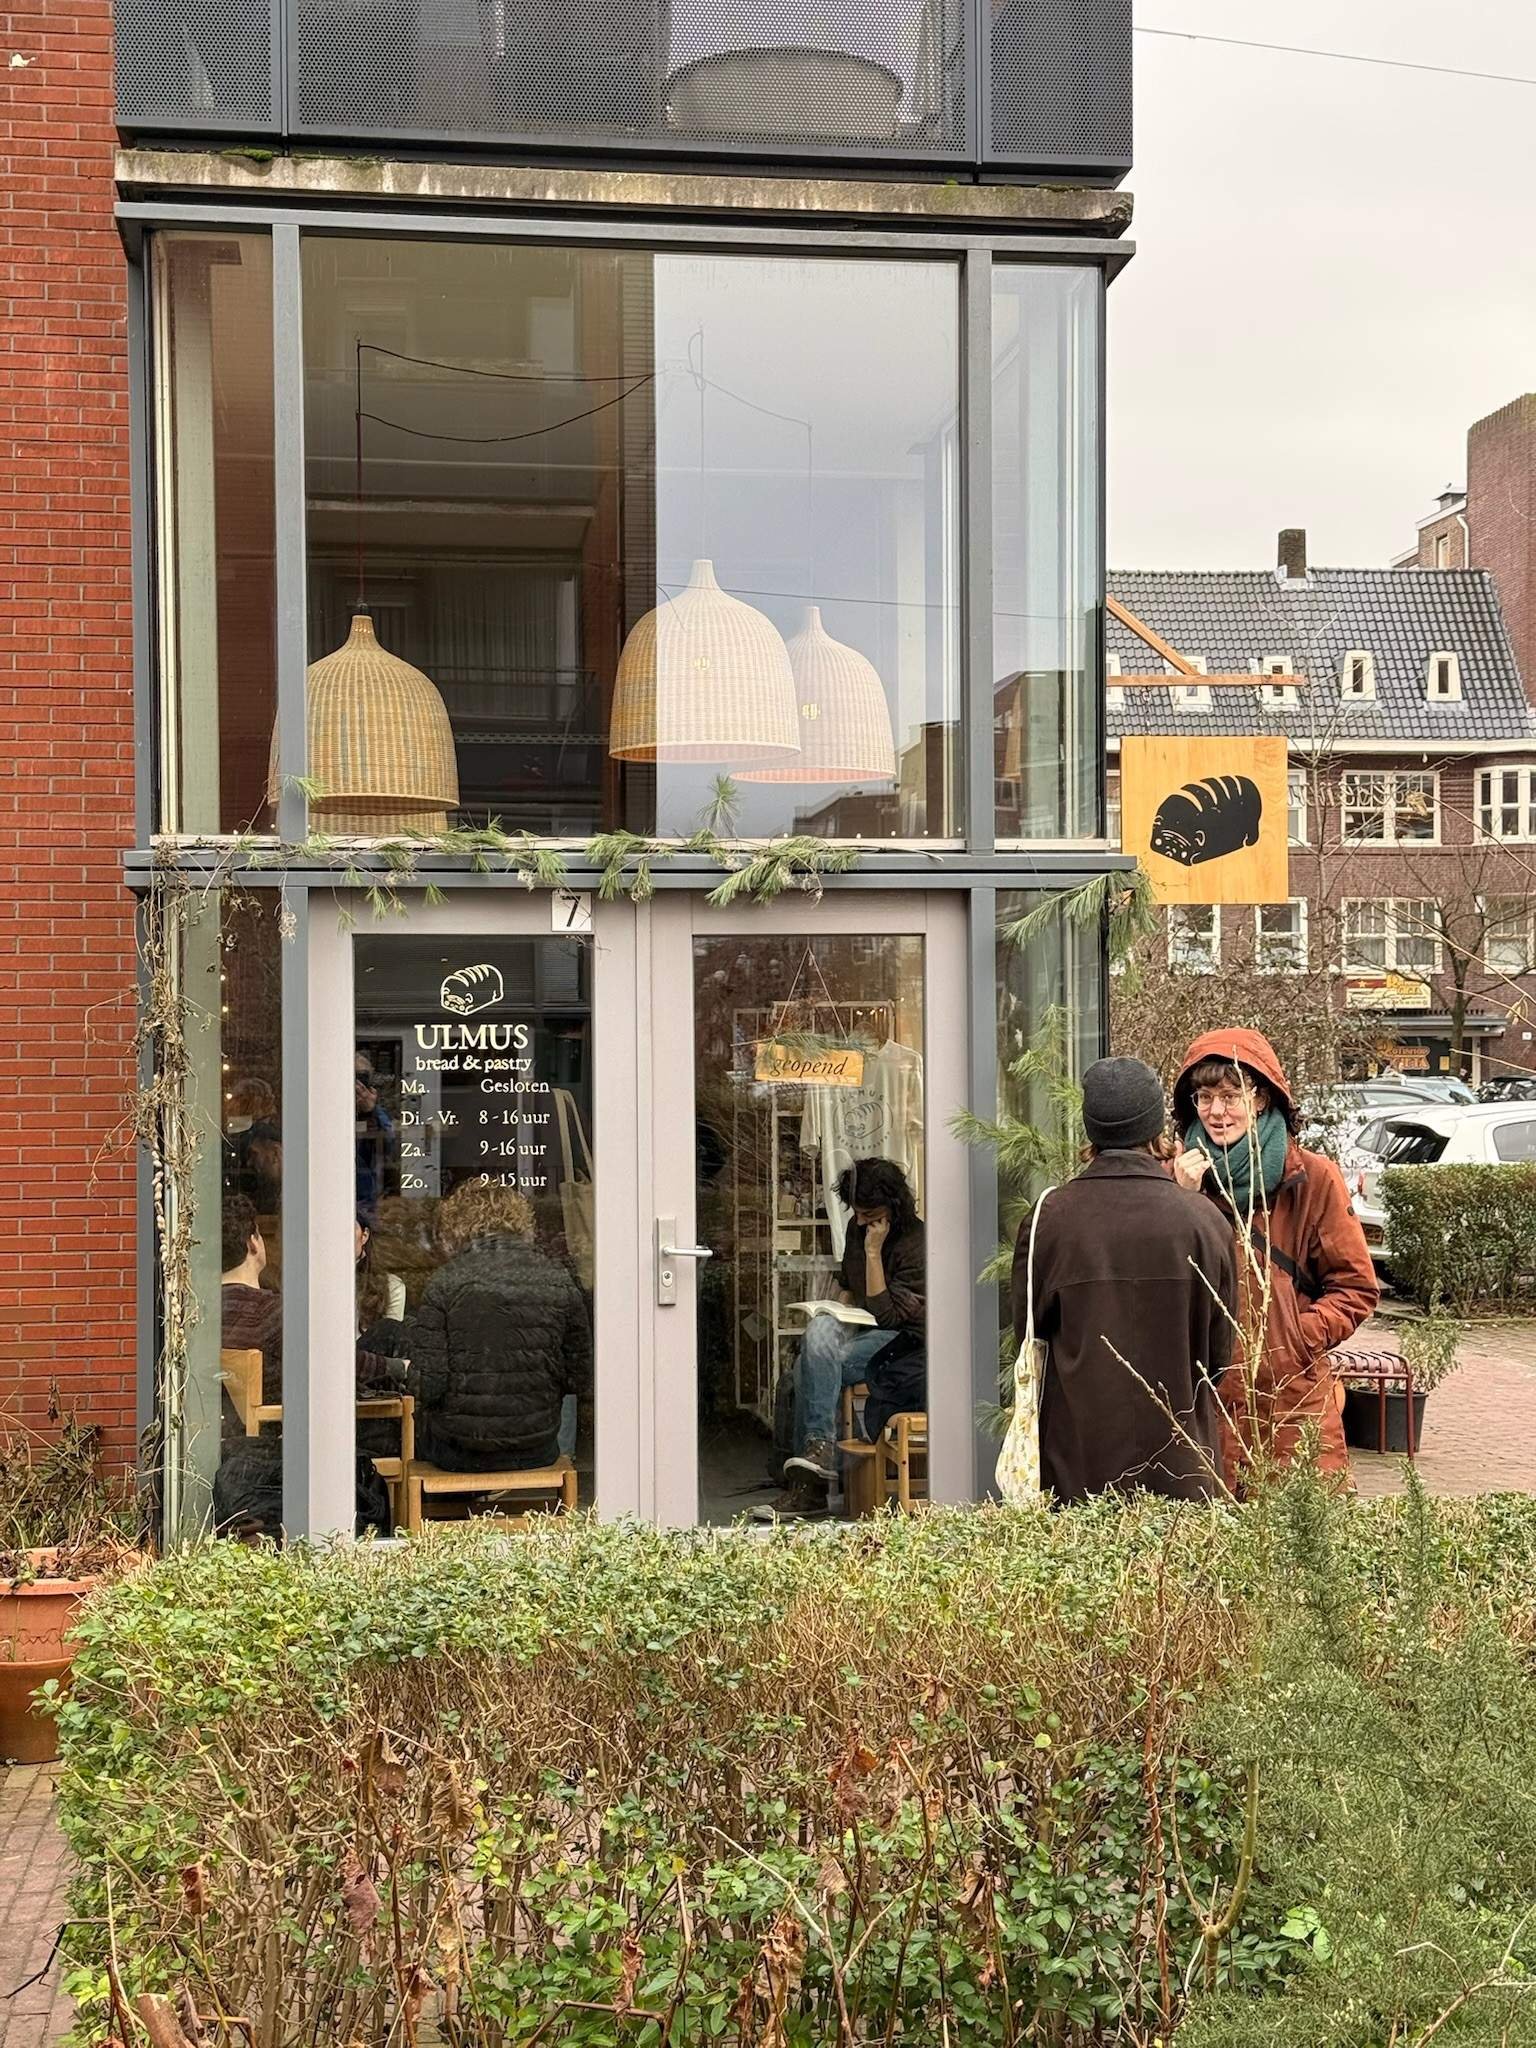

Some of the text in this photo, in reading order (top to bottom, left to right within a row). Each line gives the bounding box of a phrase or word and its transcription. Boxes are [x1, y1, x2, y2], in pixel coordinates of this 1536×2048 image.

[560, 895, 581, 927] 7
[414, 1024, 529, 1050] ULMUS
[415, 1054, 532, 1073] bread & pastry
[769, 1057, 849, 1078] geopend
[400, 1079, 550, 1094] Ma. Gesloten
[437, 1110, 460, 1125] Vr.
[522, 1112, 550, 1124] uur
[401, 1142, 426, 1157] Za.
[519, 1144, 547, 1155] uur
[401, 1174, 428, 1189] Zo.
[520, 1176, 547, 1187] uur
